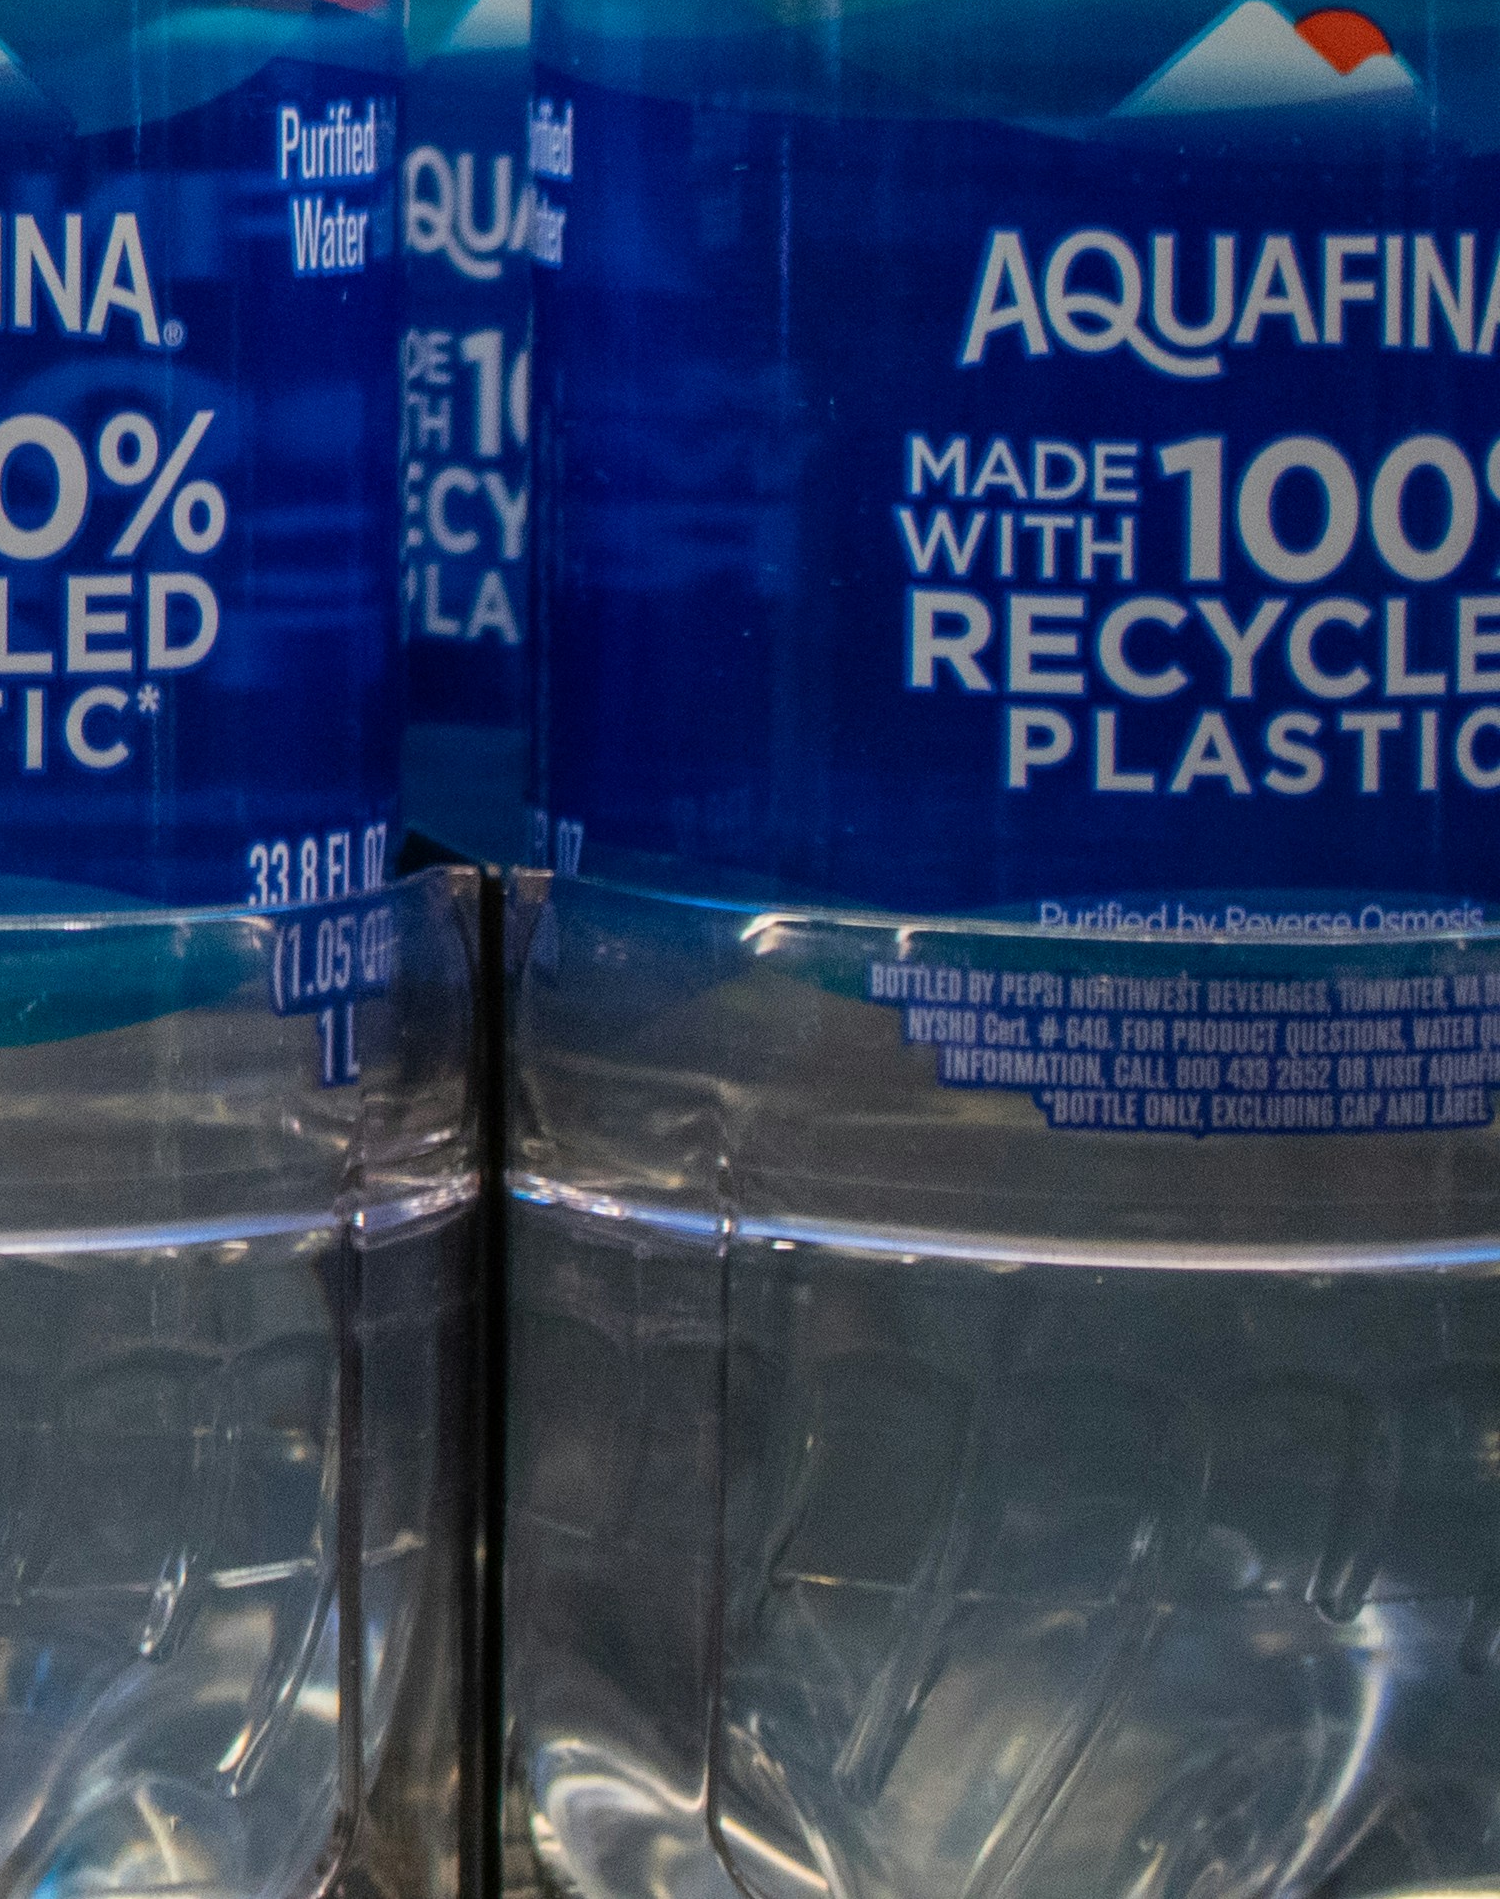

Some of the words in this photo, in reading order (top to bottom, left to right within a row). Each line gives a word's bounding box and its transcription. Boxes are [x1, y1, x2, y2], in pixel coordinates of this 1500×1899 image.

[280, 102, 377, 181] Purified
[292, 197, 368, 271] Water
[912, 437, 1137, 501] MADE
[900, 510, 1134, 578] WITH
[1161, 436, 1500, 582] 100
